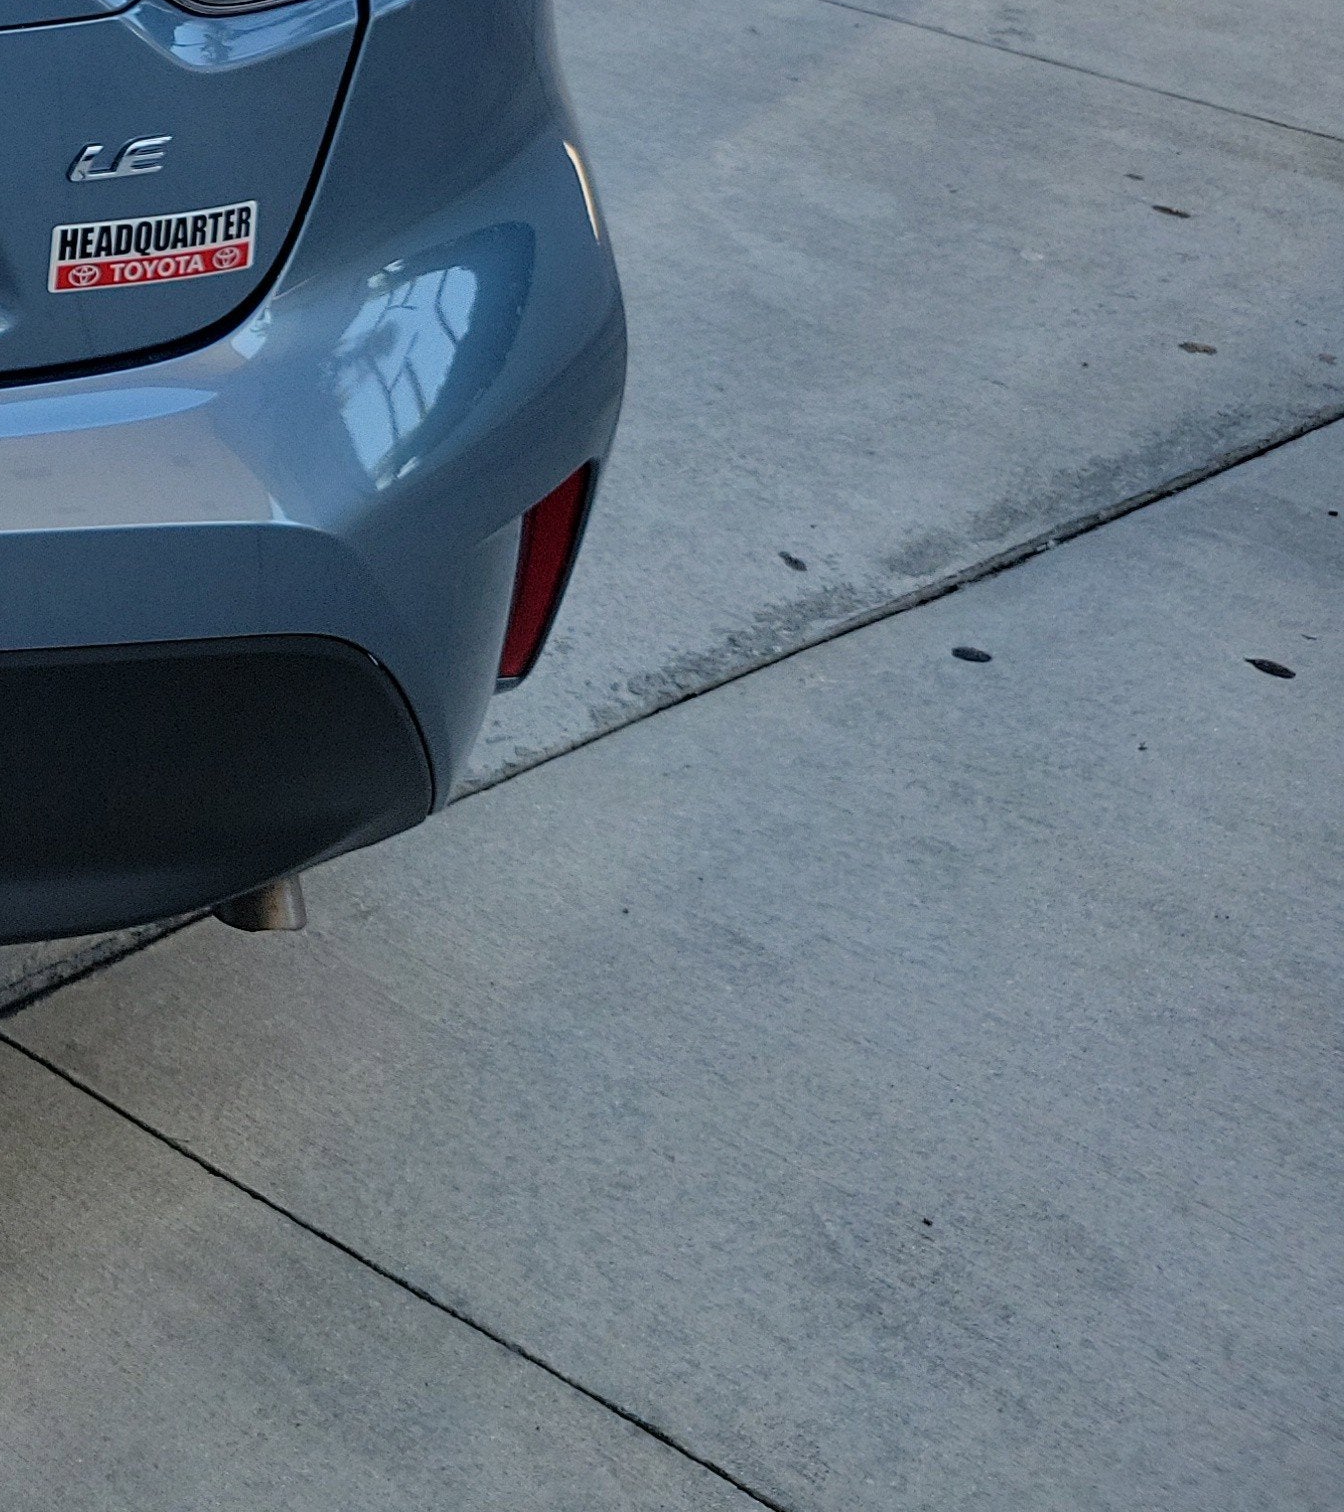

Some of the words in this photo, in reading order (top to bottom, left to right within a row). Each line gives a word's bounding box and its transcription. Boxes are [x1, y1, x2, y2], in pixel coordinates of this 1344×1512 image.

[66, 135, 173, 182] LE
[58, 205, 251, 262] HEADQUARTER
[110, 253, 205, 283] TOYOTA
